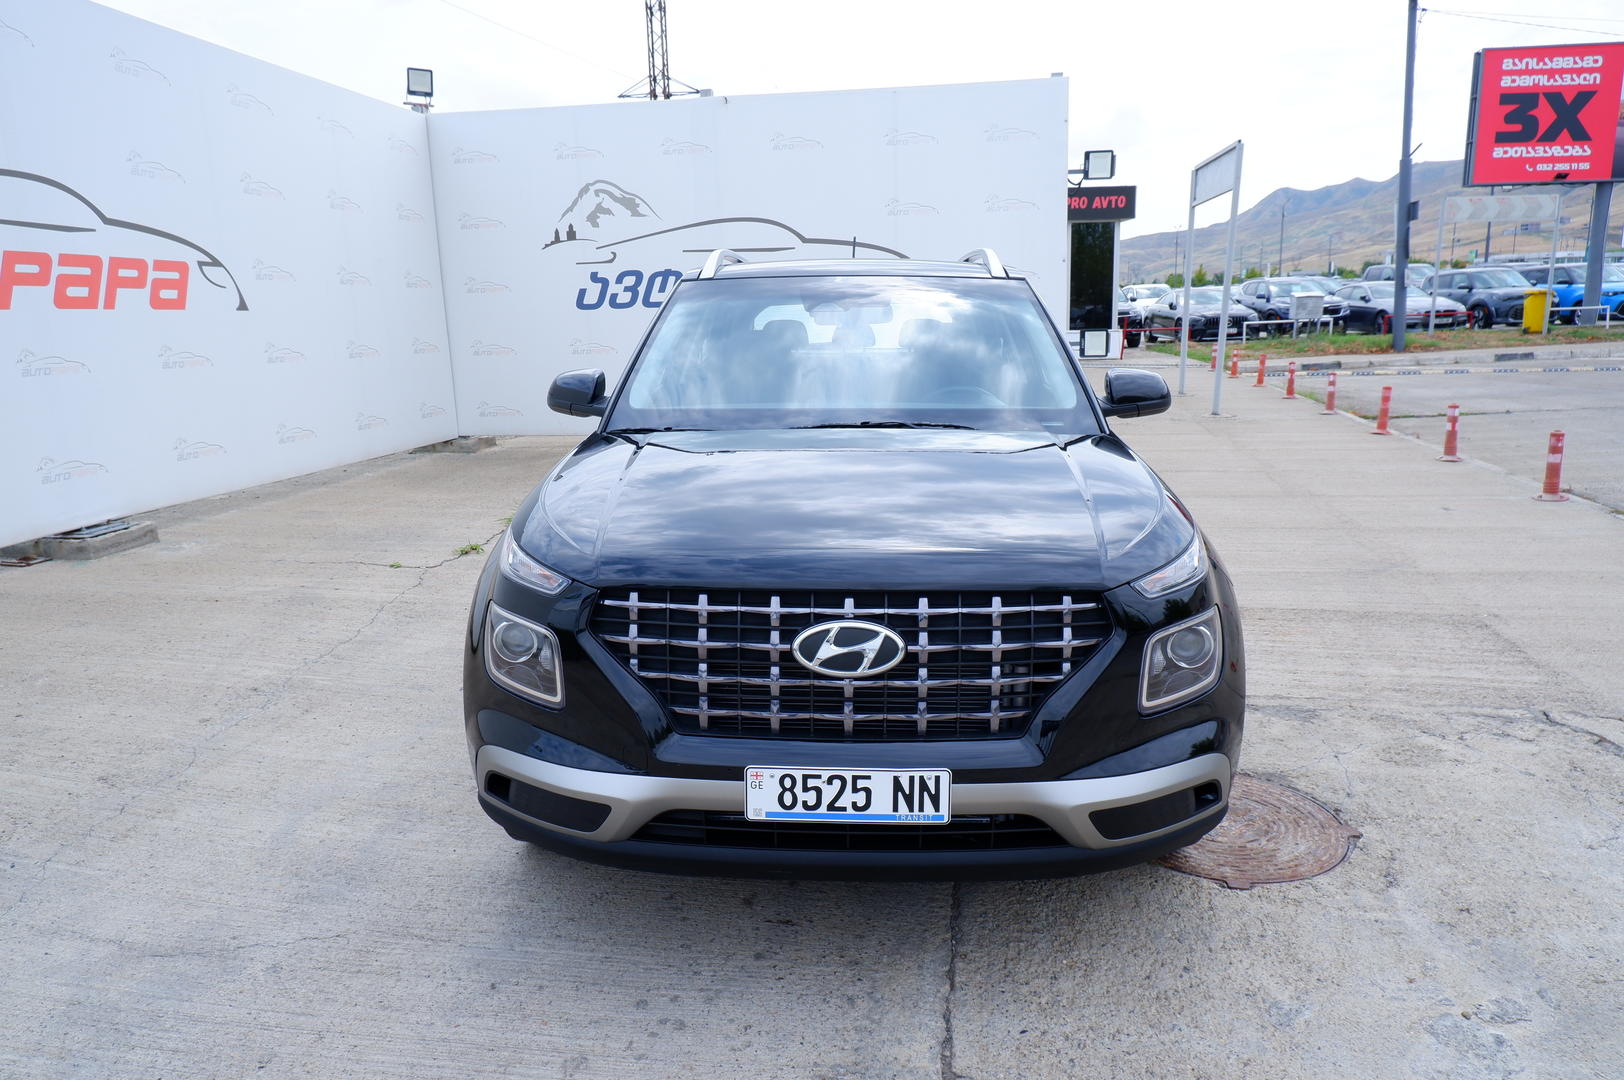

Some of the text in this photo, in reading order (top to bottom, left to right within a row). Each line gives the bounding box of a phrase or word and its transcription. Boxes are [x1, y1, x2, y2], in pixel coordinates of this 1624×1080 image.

[1495, 90, 1598, 144] 3X
[1092, 195, 1127, 209] AVTO
[750, 780, 764, 790] GE
[777, 773, 941, 814] 8525 NN
[896, 814, 934, 822] TRANSIT
